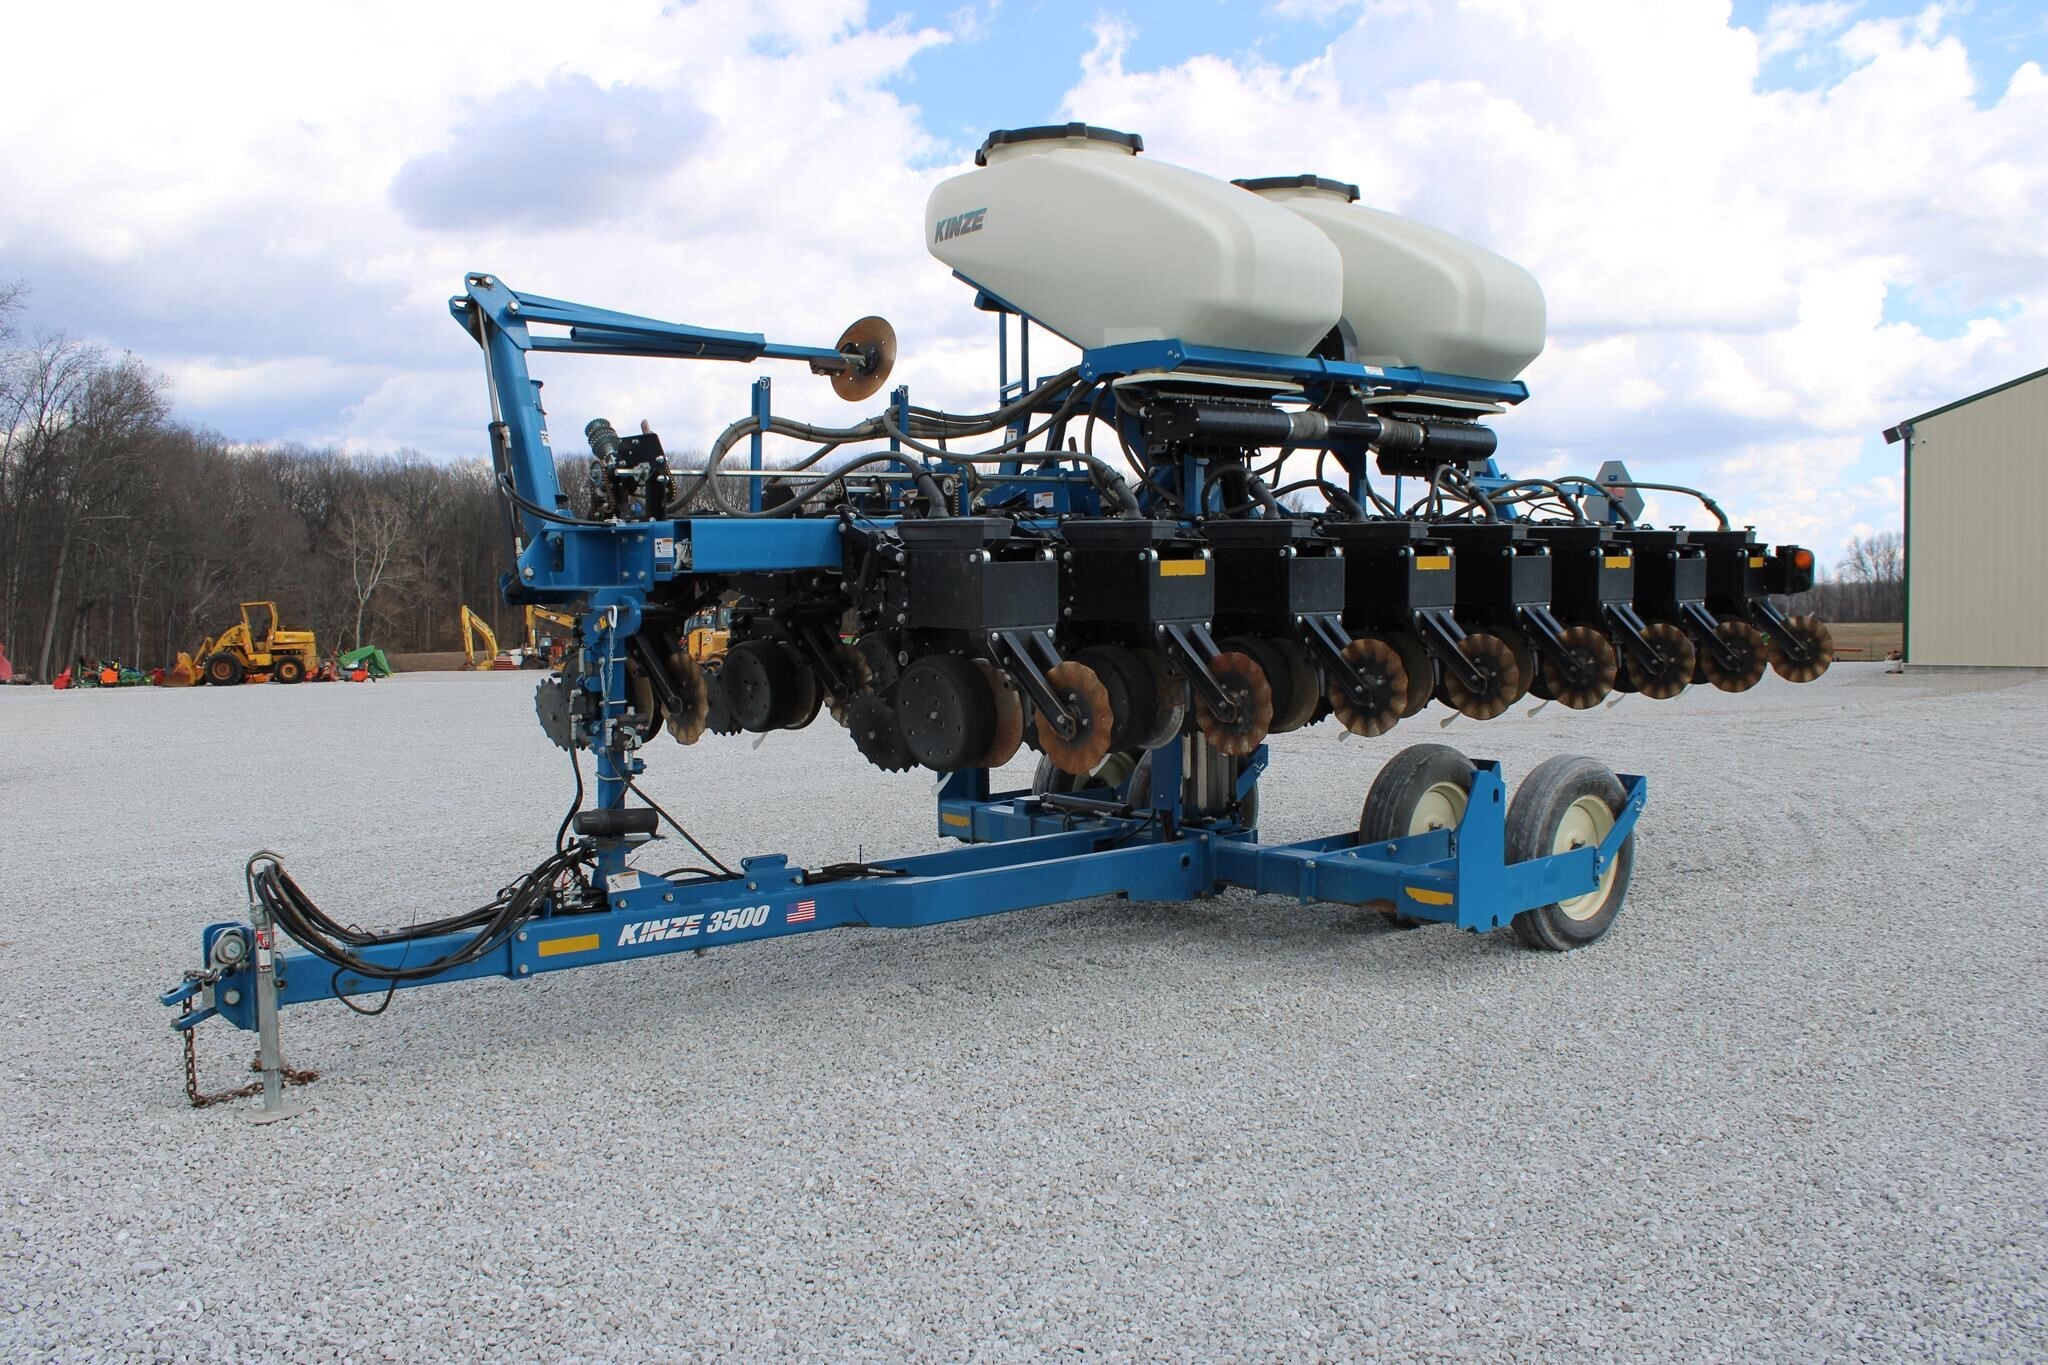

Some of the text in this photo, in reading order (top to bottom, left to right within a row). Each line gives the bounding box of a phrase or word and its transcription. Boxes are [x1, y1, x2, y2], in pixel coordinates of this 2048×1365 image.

[934, 207, 988, 244] KINZE
[617, 904, 770, 947] KINZE 3500
